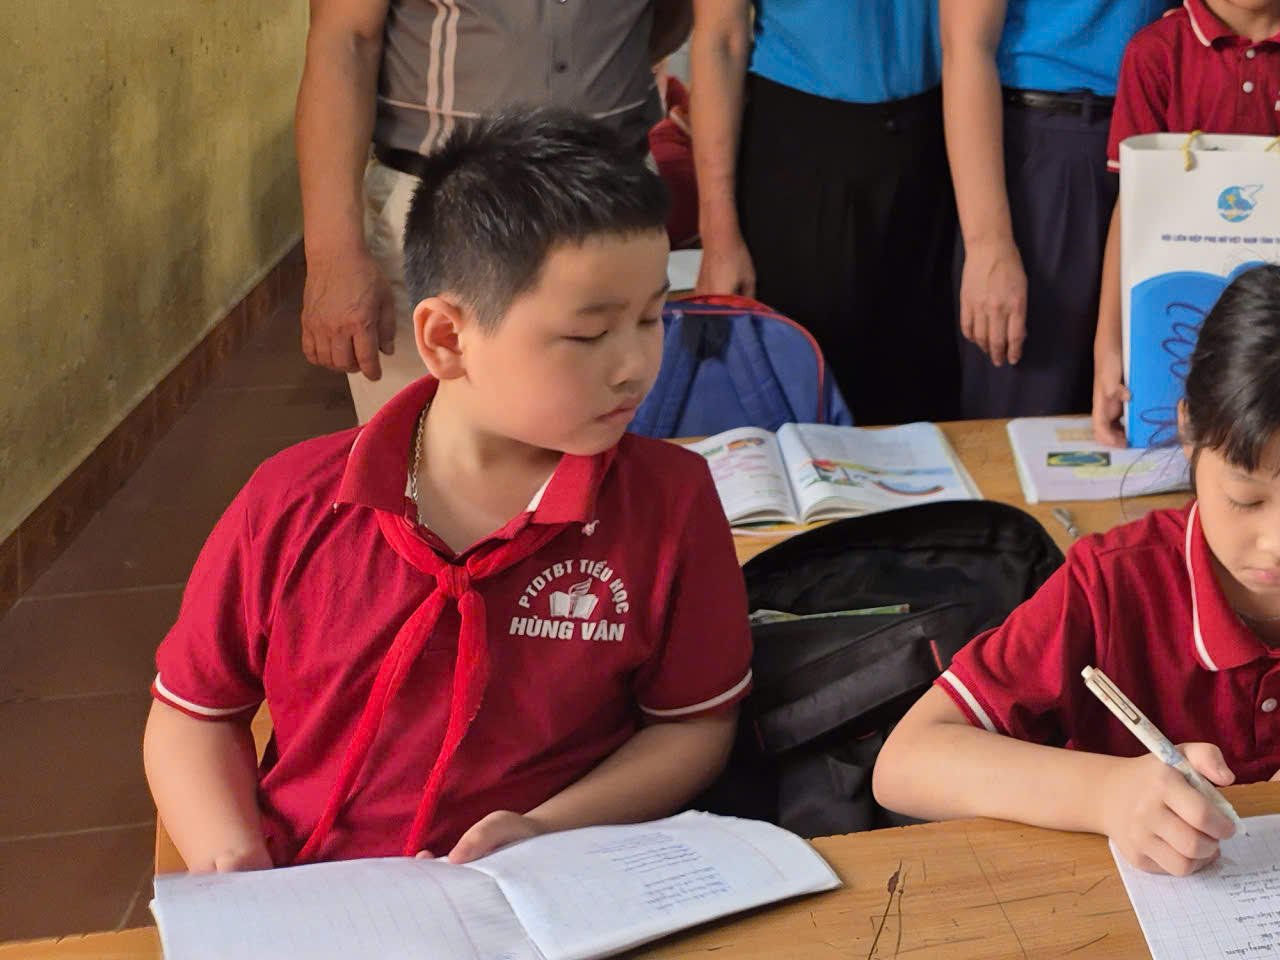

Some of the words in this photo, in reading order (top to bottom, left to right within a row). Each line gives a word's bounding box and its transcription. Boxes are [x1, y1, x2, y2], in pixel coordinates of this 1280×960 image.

[518, 559, 574, 609] PTDTBT
[579, 558, 614, 583] TIỂU
[608, 578, 630, 615] HỌC
[508, 614, 575, 640] HÙNG
[581, 619, 626, 642] VÂN
